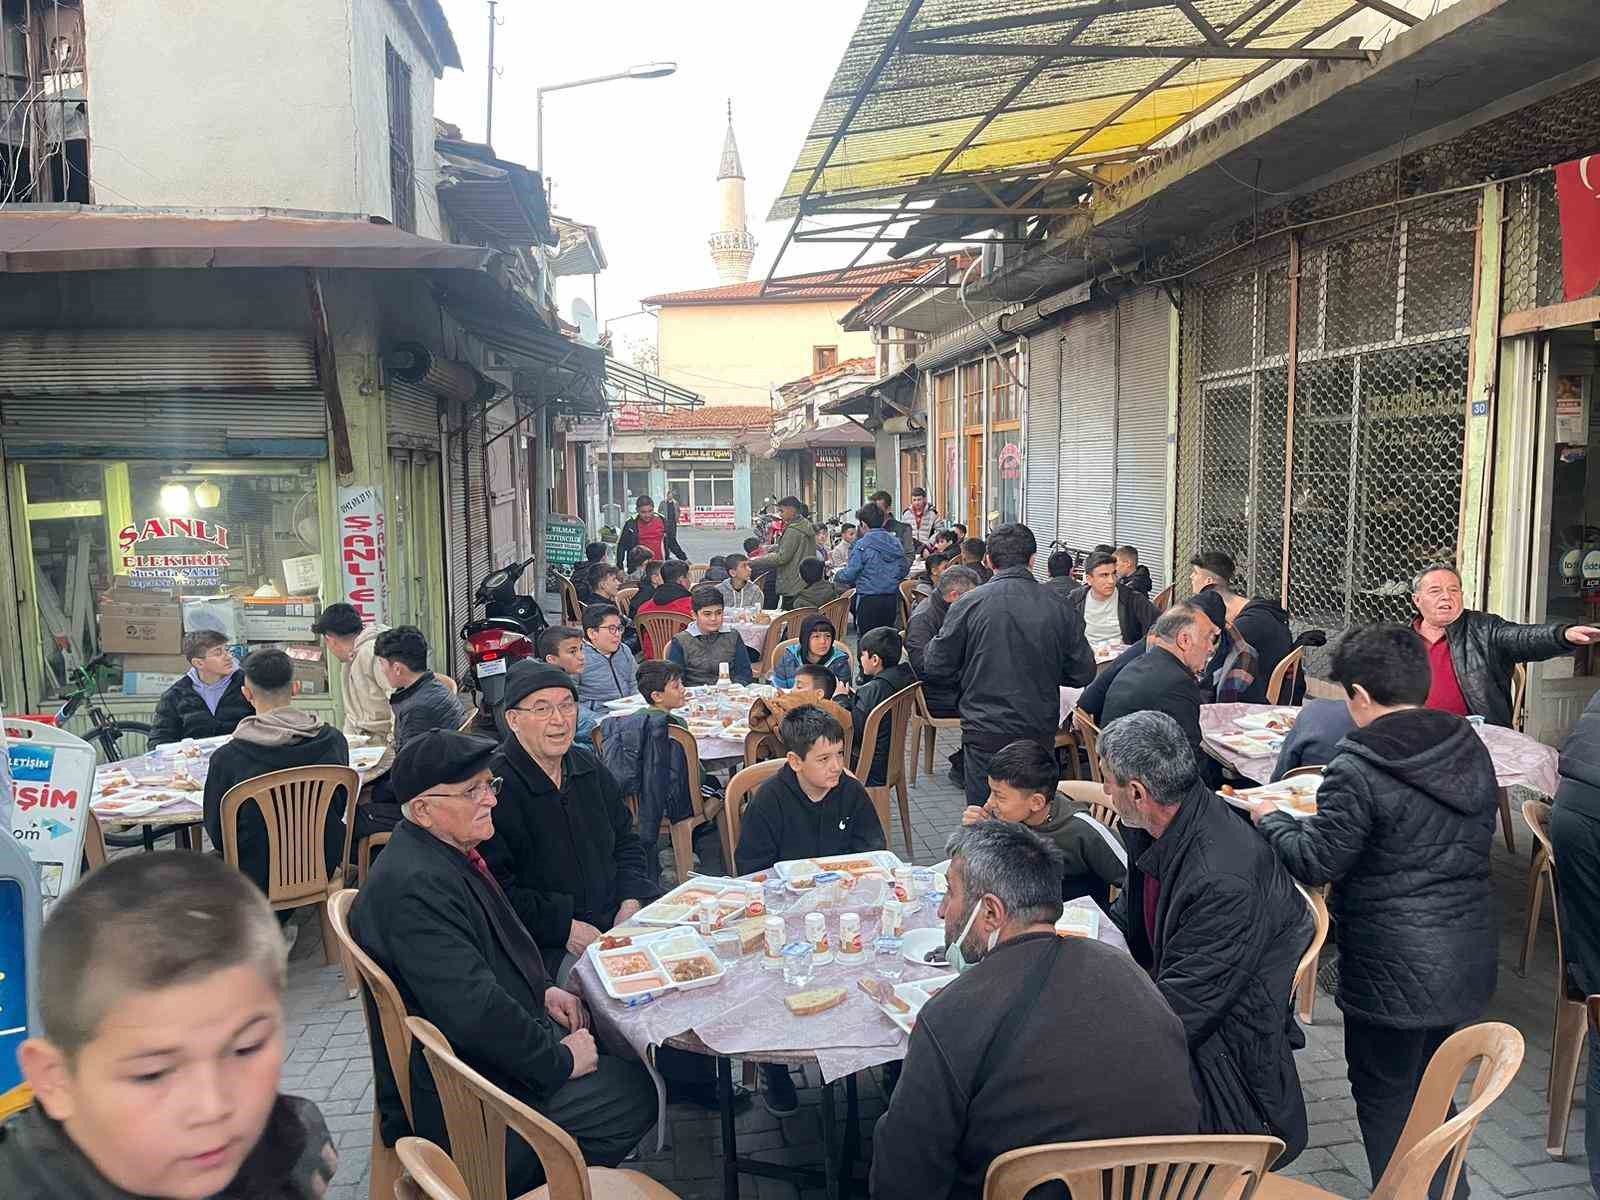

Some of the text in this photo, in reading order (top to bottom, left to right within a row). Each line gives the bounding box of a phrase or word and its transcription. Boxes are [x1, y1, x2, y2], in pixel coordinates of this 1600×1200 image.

[1473, 404, 1485, 415] 30
[118, 518, 228, 552] ŞANLI
[121, 551, 230, 568] ELEKTRİK
